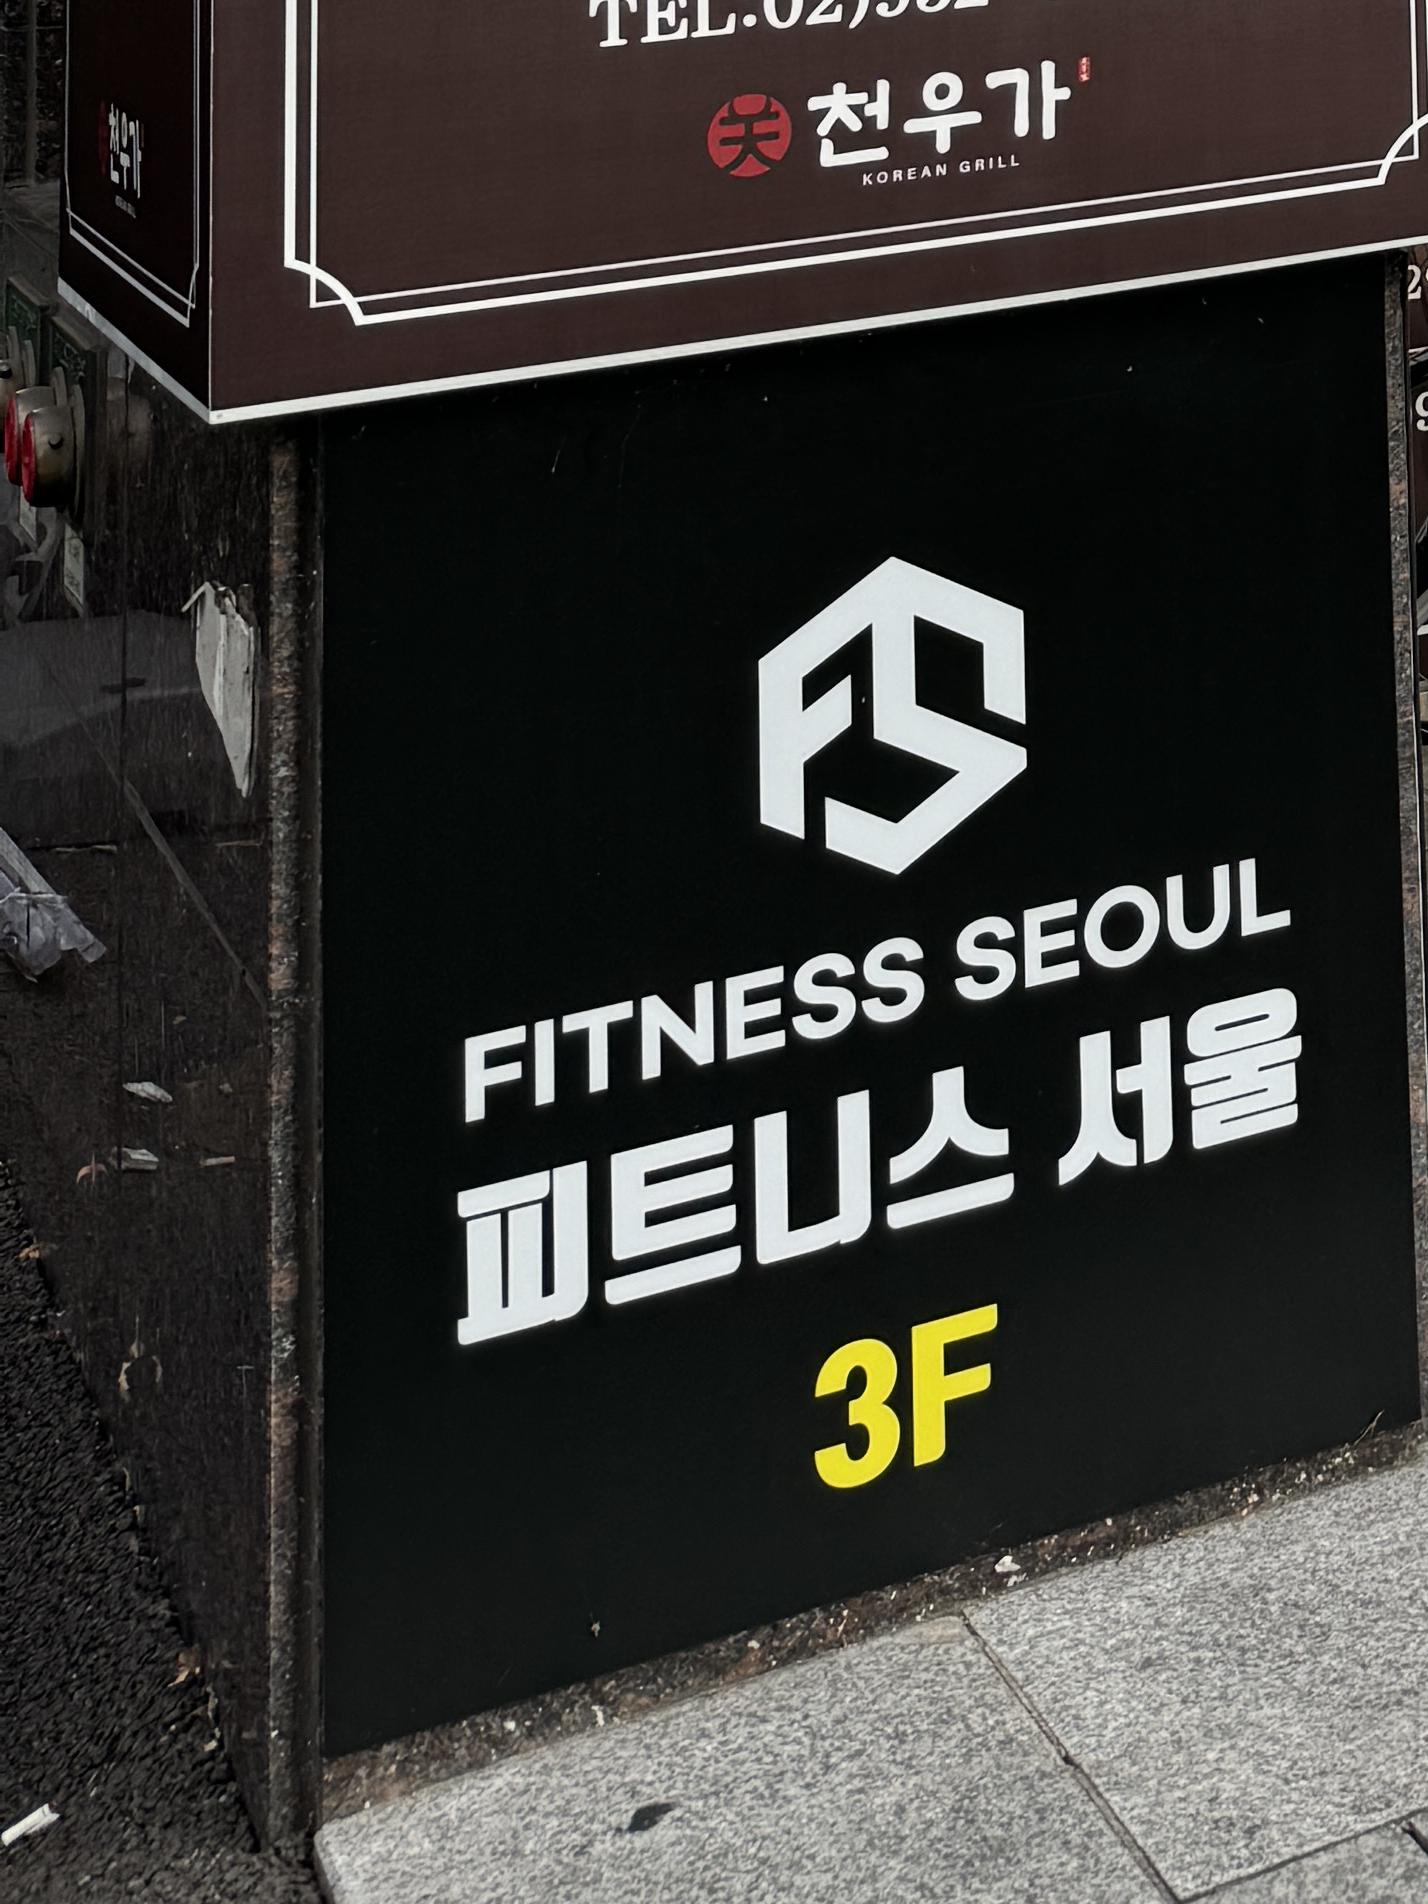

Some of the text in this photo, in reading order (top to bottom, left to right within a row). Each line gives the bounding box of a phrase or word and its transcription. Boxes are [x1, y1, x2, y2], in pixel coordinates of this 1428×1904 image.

[108, 102, 142, 209] 천우가
[807, 60, 1071, 168] 천우가
[862, 154, 1021, 186] KOREAN GRILL
[463, 857, 1291, 1125] FITNESS SEOUL
[456, 987, 1303, 1347] 피트니스 서울
[813, 1303, 999, 1490] 3F
